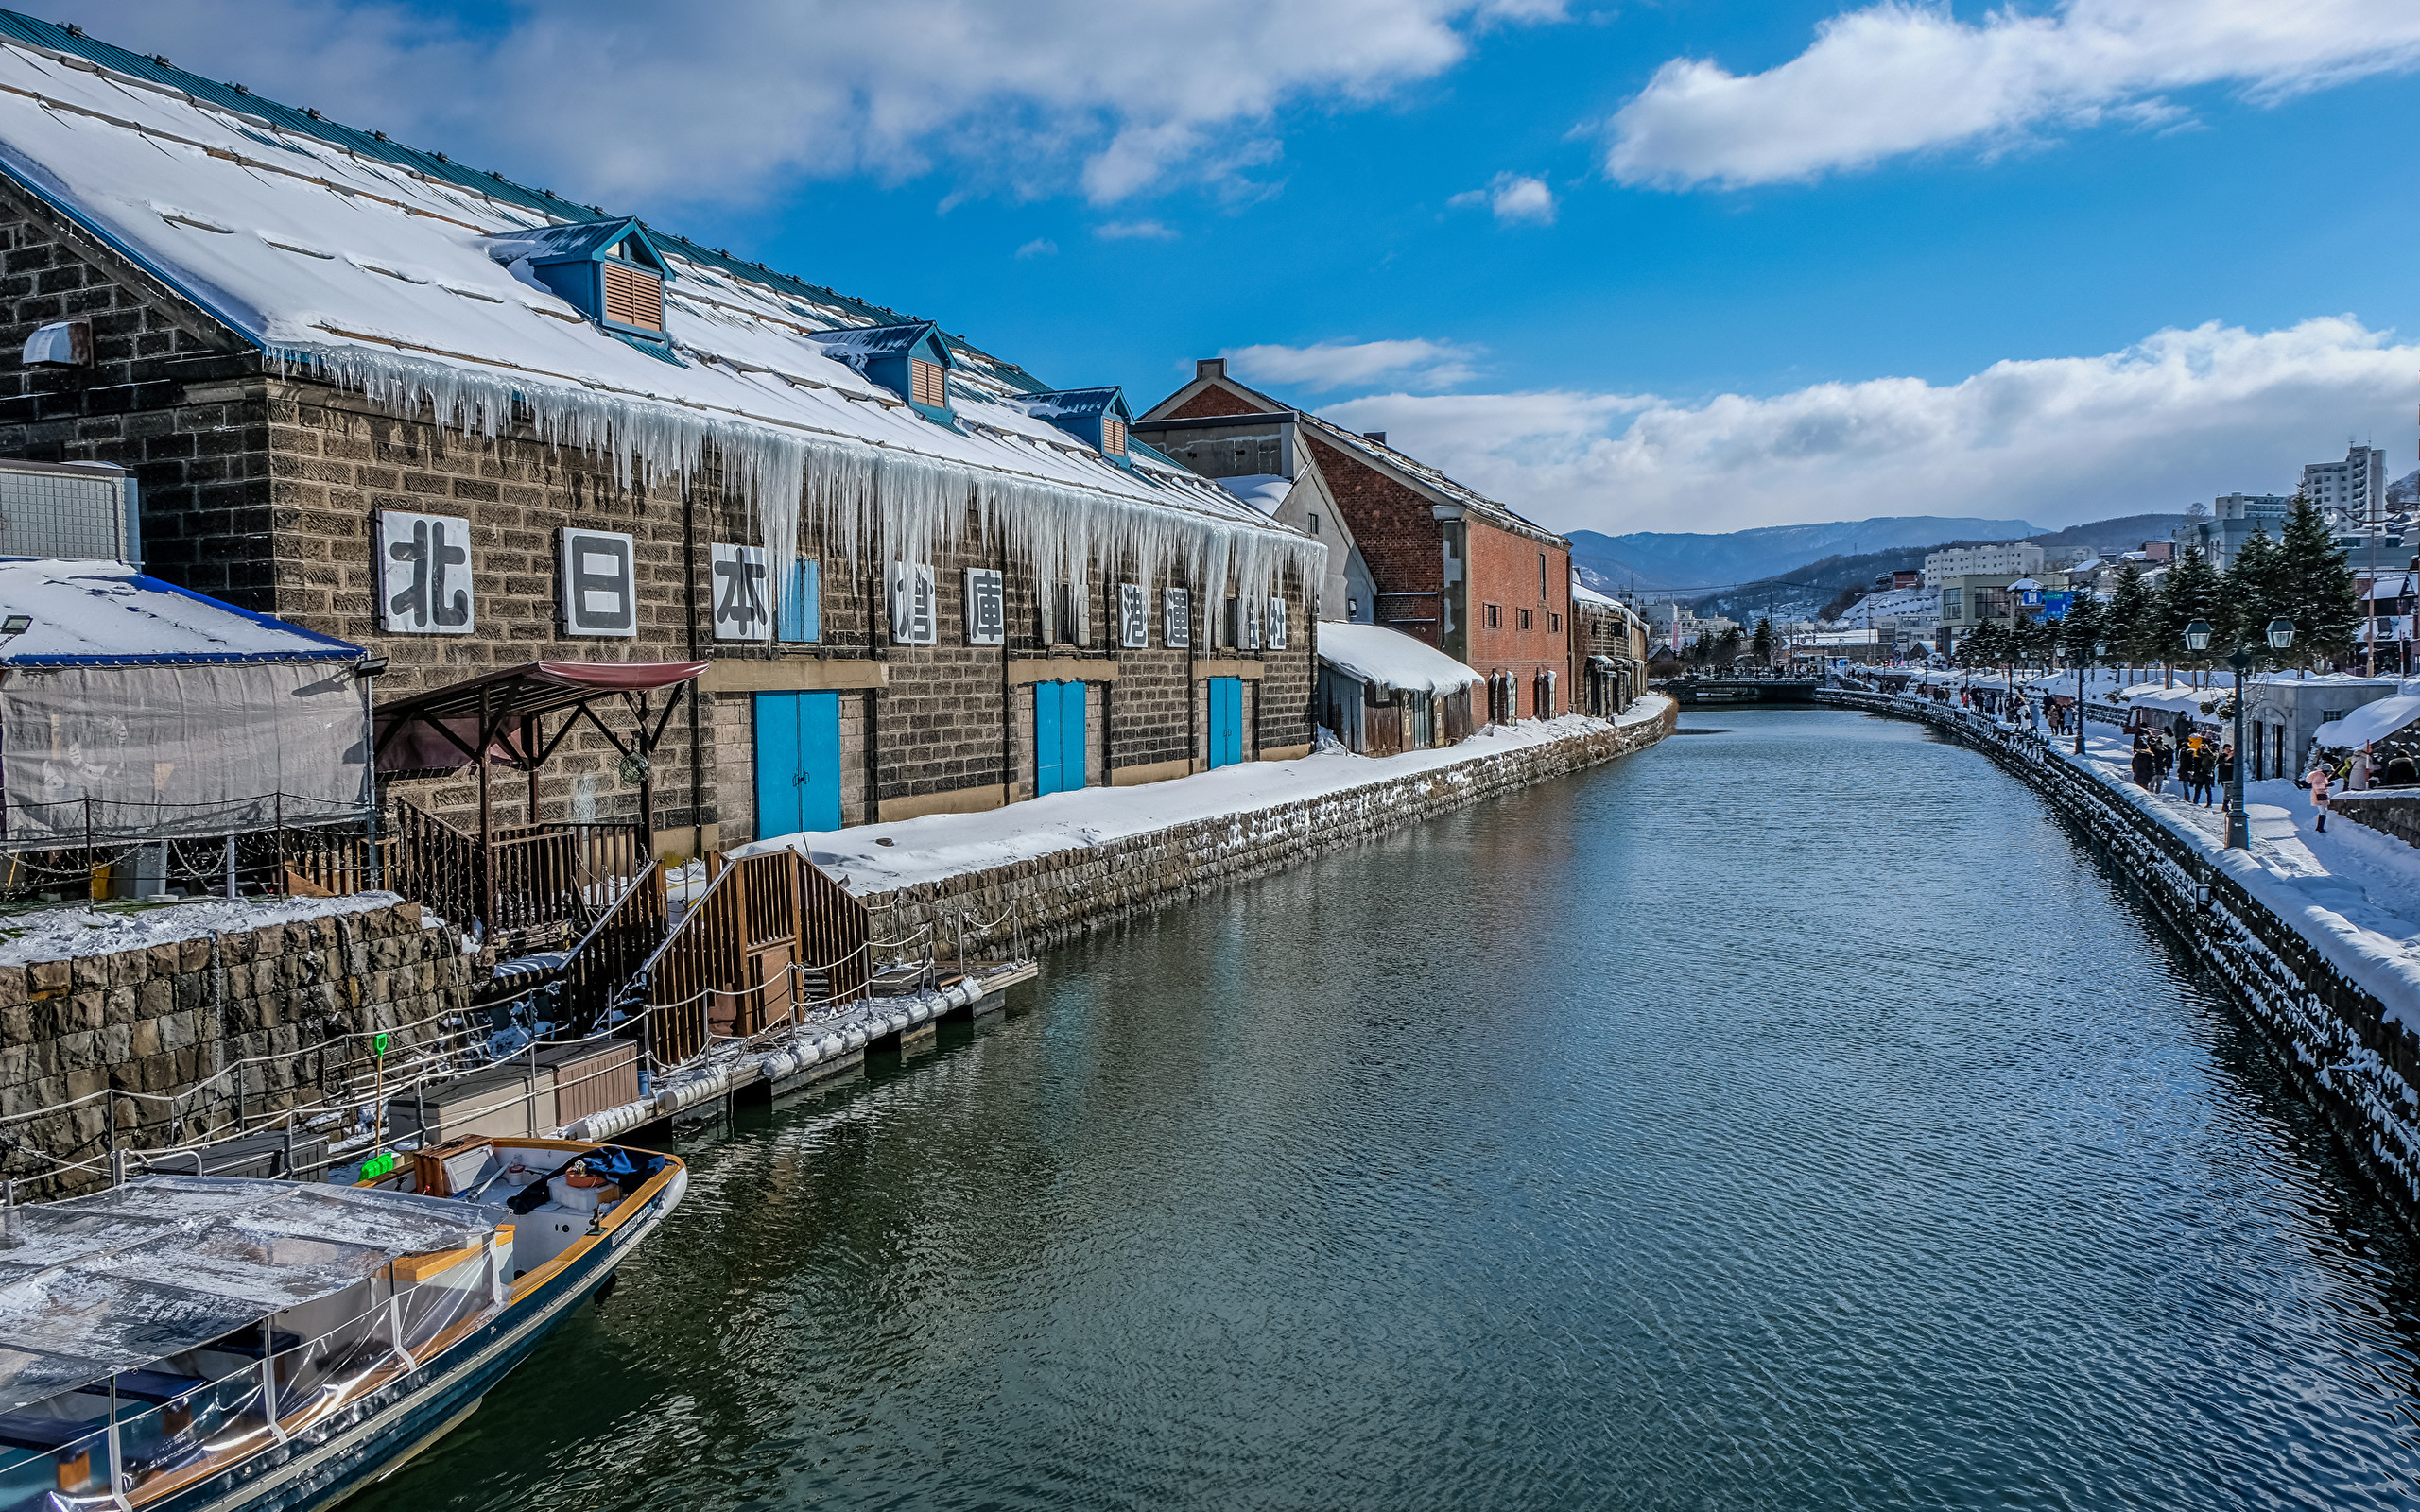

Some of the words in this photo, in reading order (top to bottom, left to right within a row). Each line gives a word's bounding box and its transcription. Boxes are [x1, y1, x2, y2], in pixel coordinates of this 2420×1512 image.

[389, 519, 467, 627] 北
[572, 535, 631, 629] 日
[714, 547, 769, 636] 本
